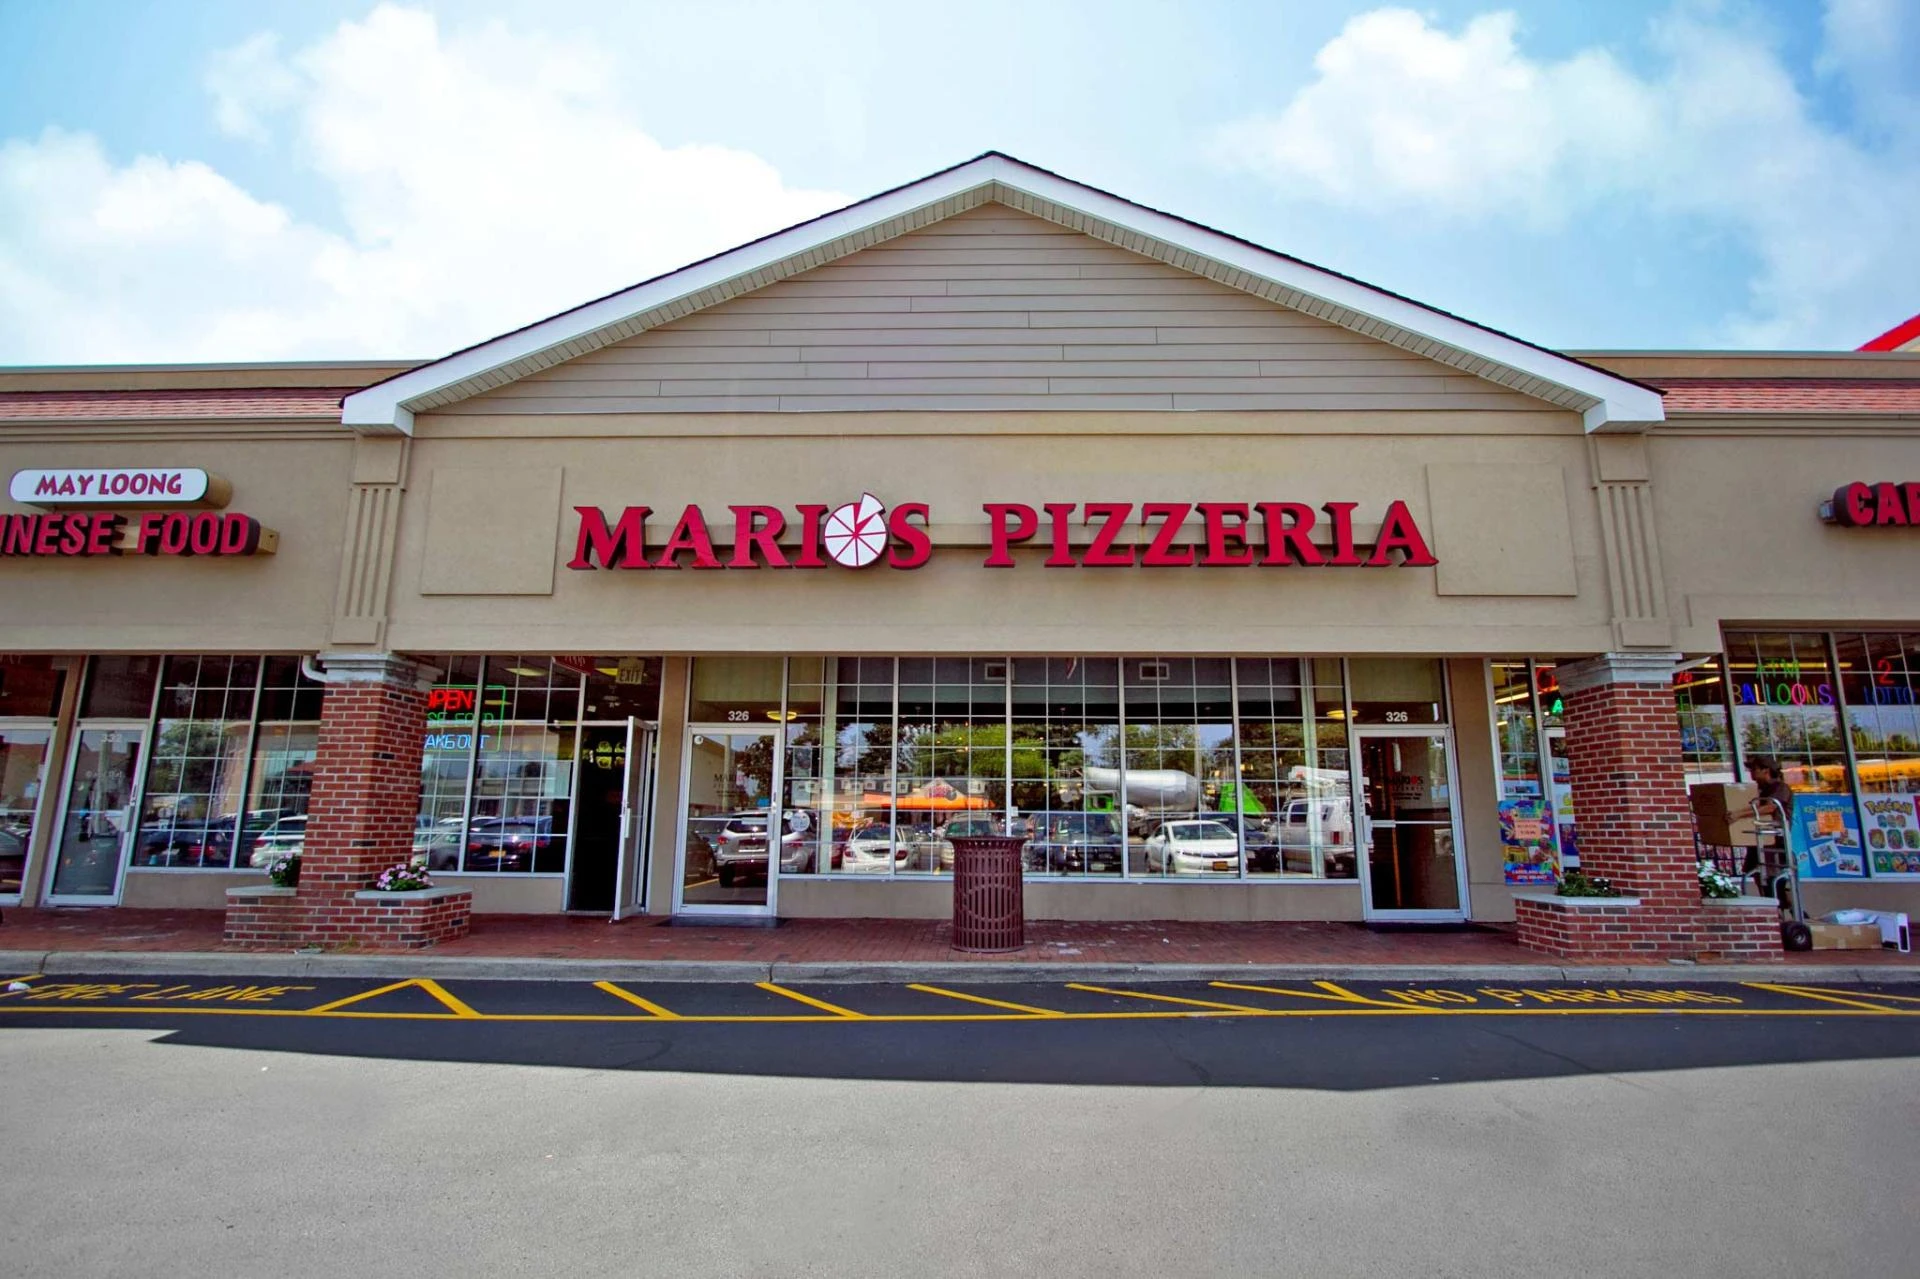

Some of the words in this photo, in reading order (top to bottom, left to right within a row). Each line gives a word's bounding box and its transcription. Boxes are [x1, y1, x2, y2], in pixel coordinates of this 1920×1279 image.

[35, 475, 94, 496] MAY
[98, 474, 182, 495] LOONG
[137, 511, 249, 554] FOOD
[983, 501, 1439, 568] PIZZERIA
[1756, 657, 1800, 678] ATM
[1732, 683, 1834, 706] BALLOONS
[1863, 687, 1916, 705] LOTTO
[455, 712, 494, 728] FOD
[728, 711, 750, 721] 326
[1385, 711, 1408, 722] 326
[1381, 988, 1478, 1003] NO
[1476, 988, 1743, 1004] PARKING
